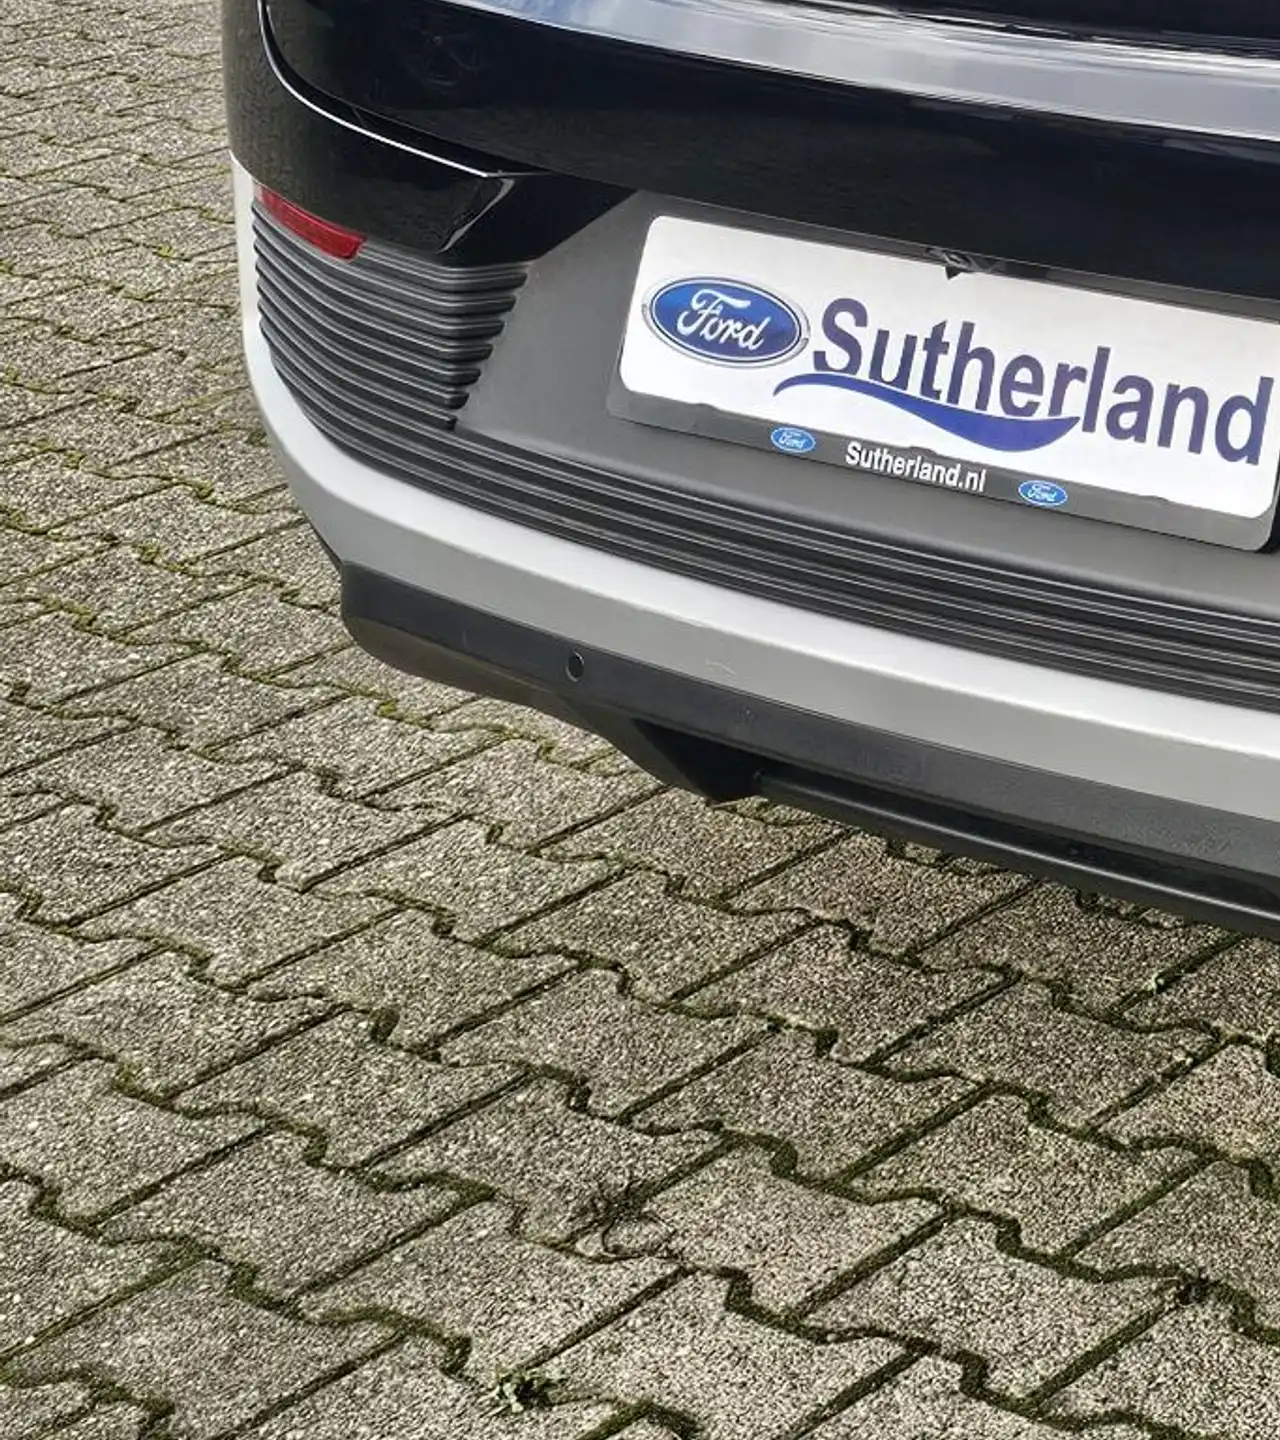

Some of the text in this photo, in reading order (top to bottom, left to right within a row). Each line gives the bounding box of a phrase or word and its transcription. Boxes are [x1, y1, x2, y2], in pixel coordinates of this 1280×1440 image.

[676, 288, 1275, 466] Ford Sutherland
[844, 440, 987, 493] Sutherland.nl
